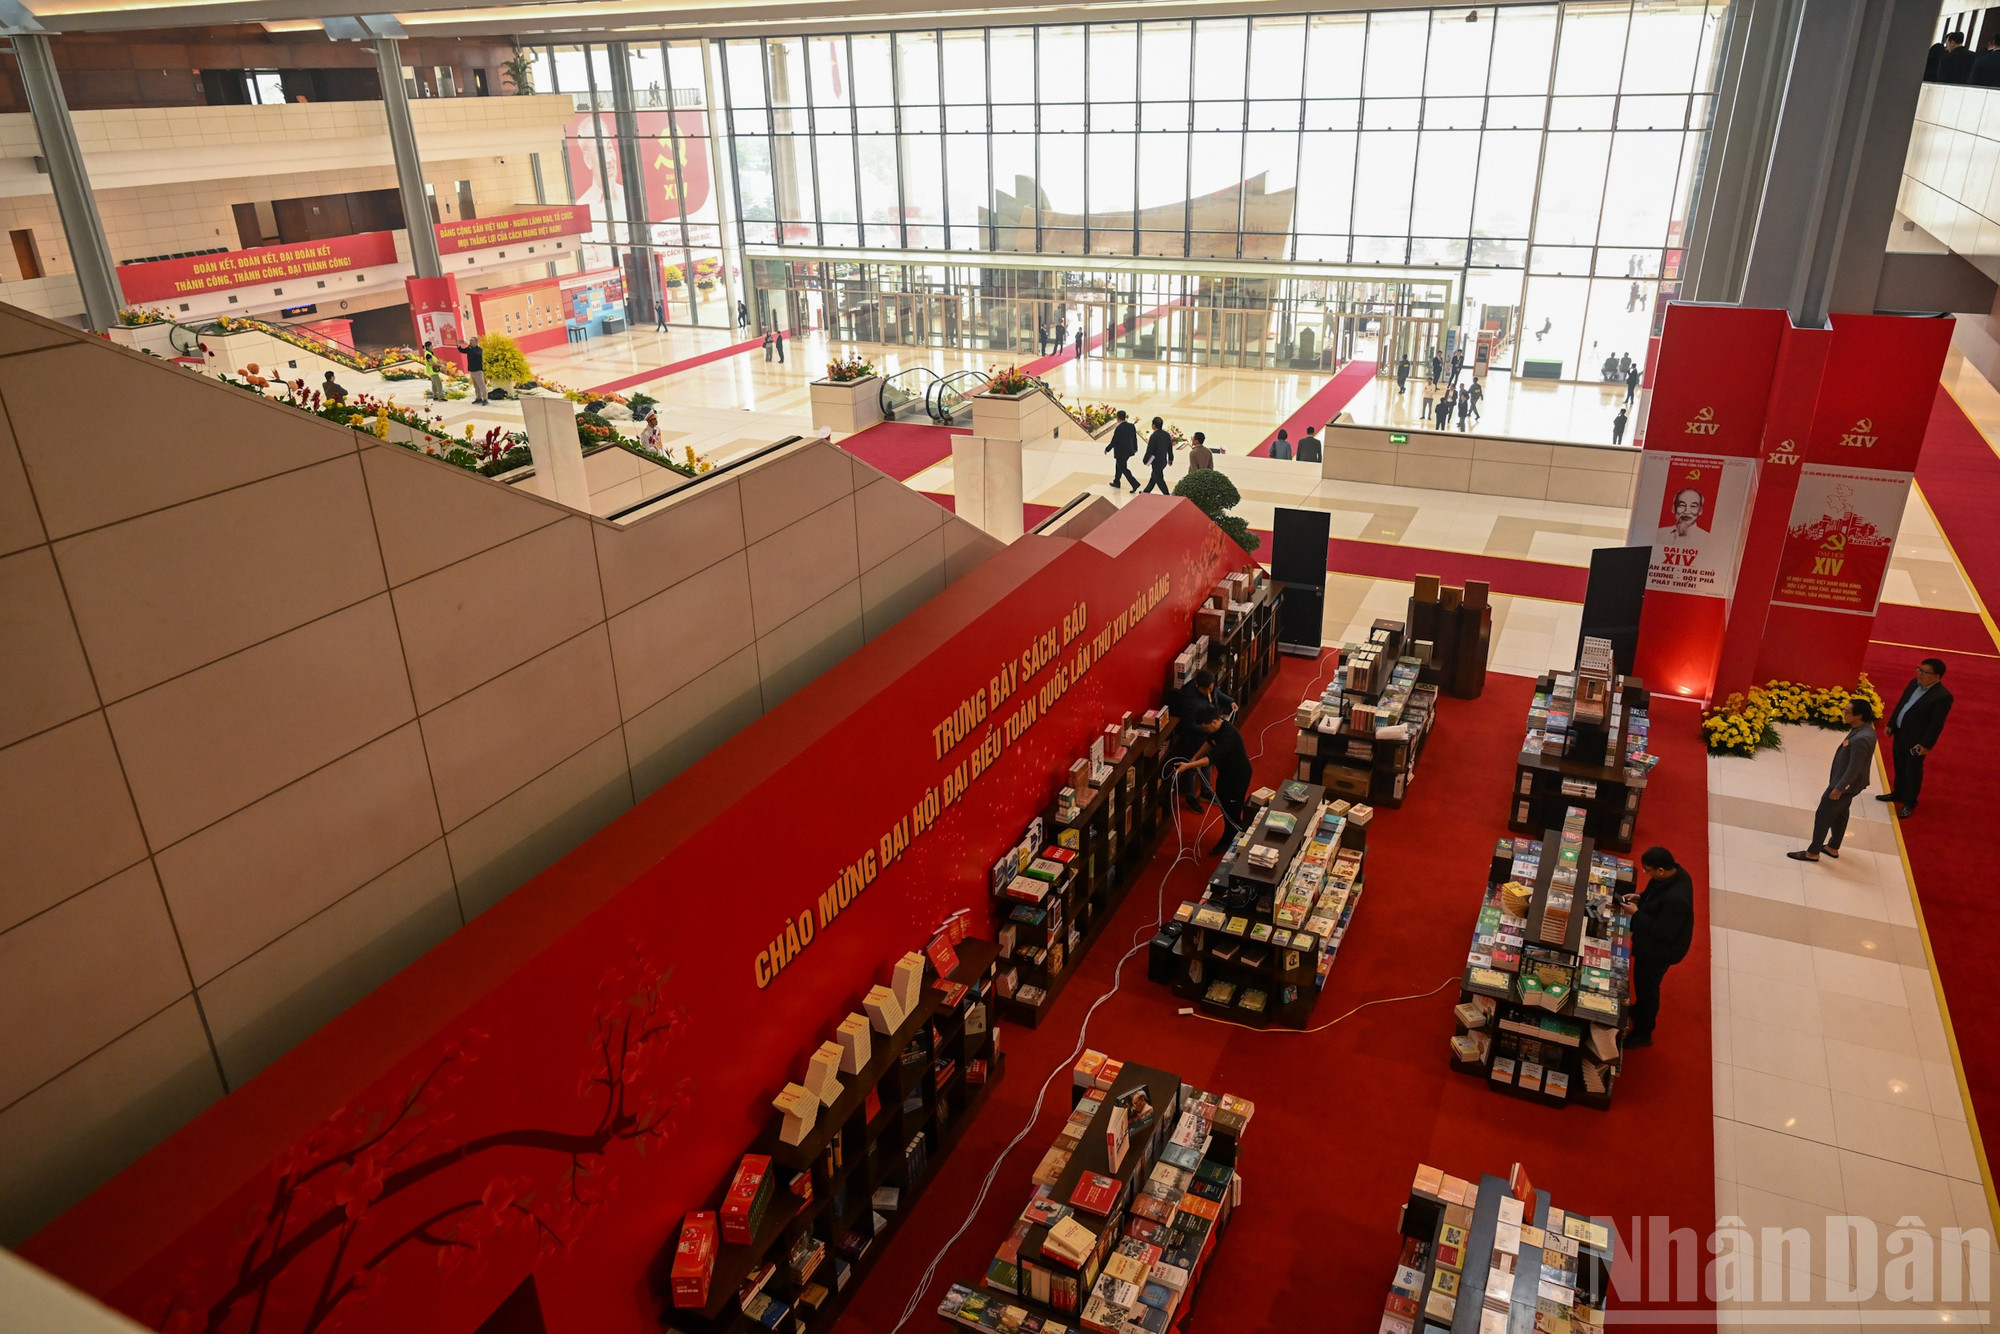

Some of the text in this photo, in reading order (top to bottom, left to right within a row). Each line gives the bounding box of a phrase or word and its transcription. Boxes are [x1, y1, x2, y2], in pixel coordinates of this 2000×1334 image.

[440, 228, 456, 238] ĐẢNG
[457, 225, 472, 236] CỘNG
[473, 222, 484, 234] SẢN
[485, 221, 495, 232] VIỆT
[497, 220, 509, 230] NAM
[193, 244, 331, 275] ĐOÀN KẾT, ĐOÀN KẾT, ĐẠI ĐOÀN KẾT
[174, 256, 352, 292] THÀNH CÔNG, THÀNH CÔNG, ĐẠI THÀNH CÔNG!
[1684, 422, 1720, 435] XIV
[1840, 434, 1879, 448] XIV
[1767, 453, 1800, 465] XIV
[1662, 553, 1696, 566] XIV
[1812, 557, 1844, 576] XIV
[1661, 564, 1675, 572] KẾT
[1699, 569, 1715, 577] CHỦ
[1651, 578, 1670, 586] PHÁT
[1682, 575, 1698, 583] ĐỘT
[932, 601, 1087, 760] TRƯNG BÀY SÁCH, BÁO
[755, 572, 1170, 989] CHÀO MỪNG ĐẠI HỘI ĐẠI BIỂU TOÀN QUỐC LẦN THỨ XIV CỦA ĐẢNG
